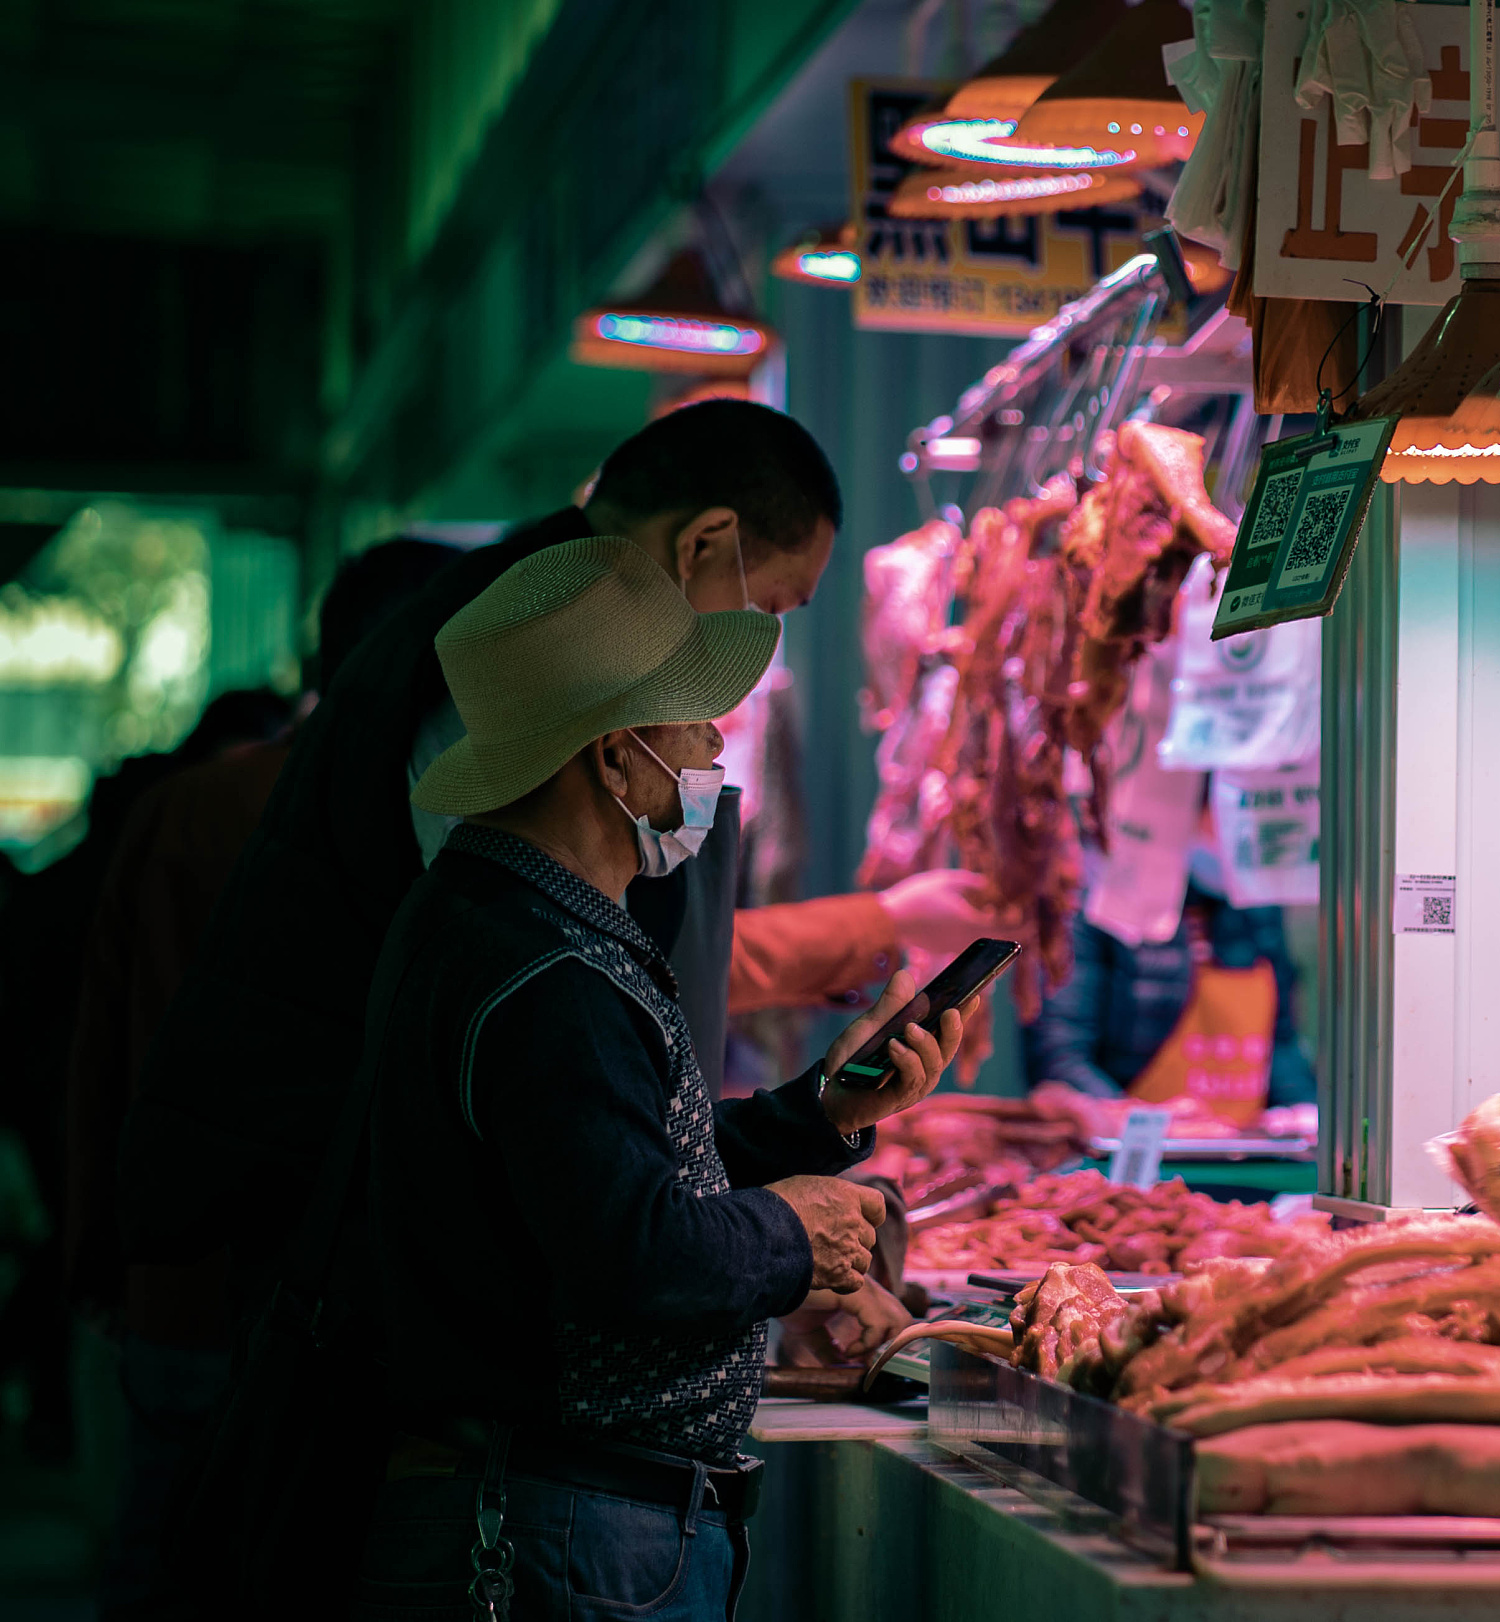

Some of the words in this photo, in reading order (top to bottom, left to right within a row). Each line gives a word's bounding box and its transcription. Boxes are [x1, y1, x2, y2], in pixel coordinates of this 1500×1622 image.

[1343, 437, 1361, 449] 支付宝
[1241, 592, 1265, 607] 微信支
